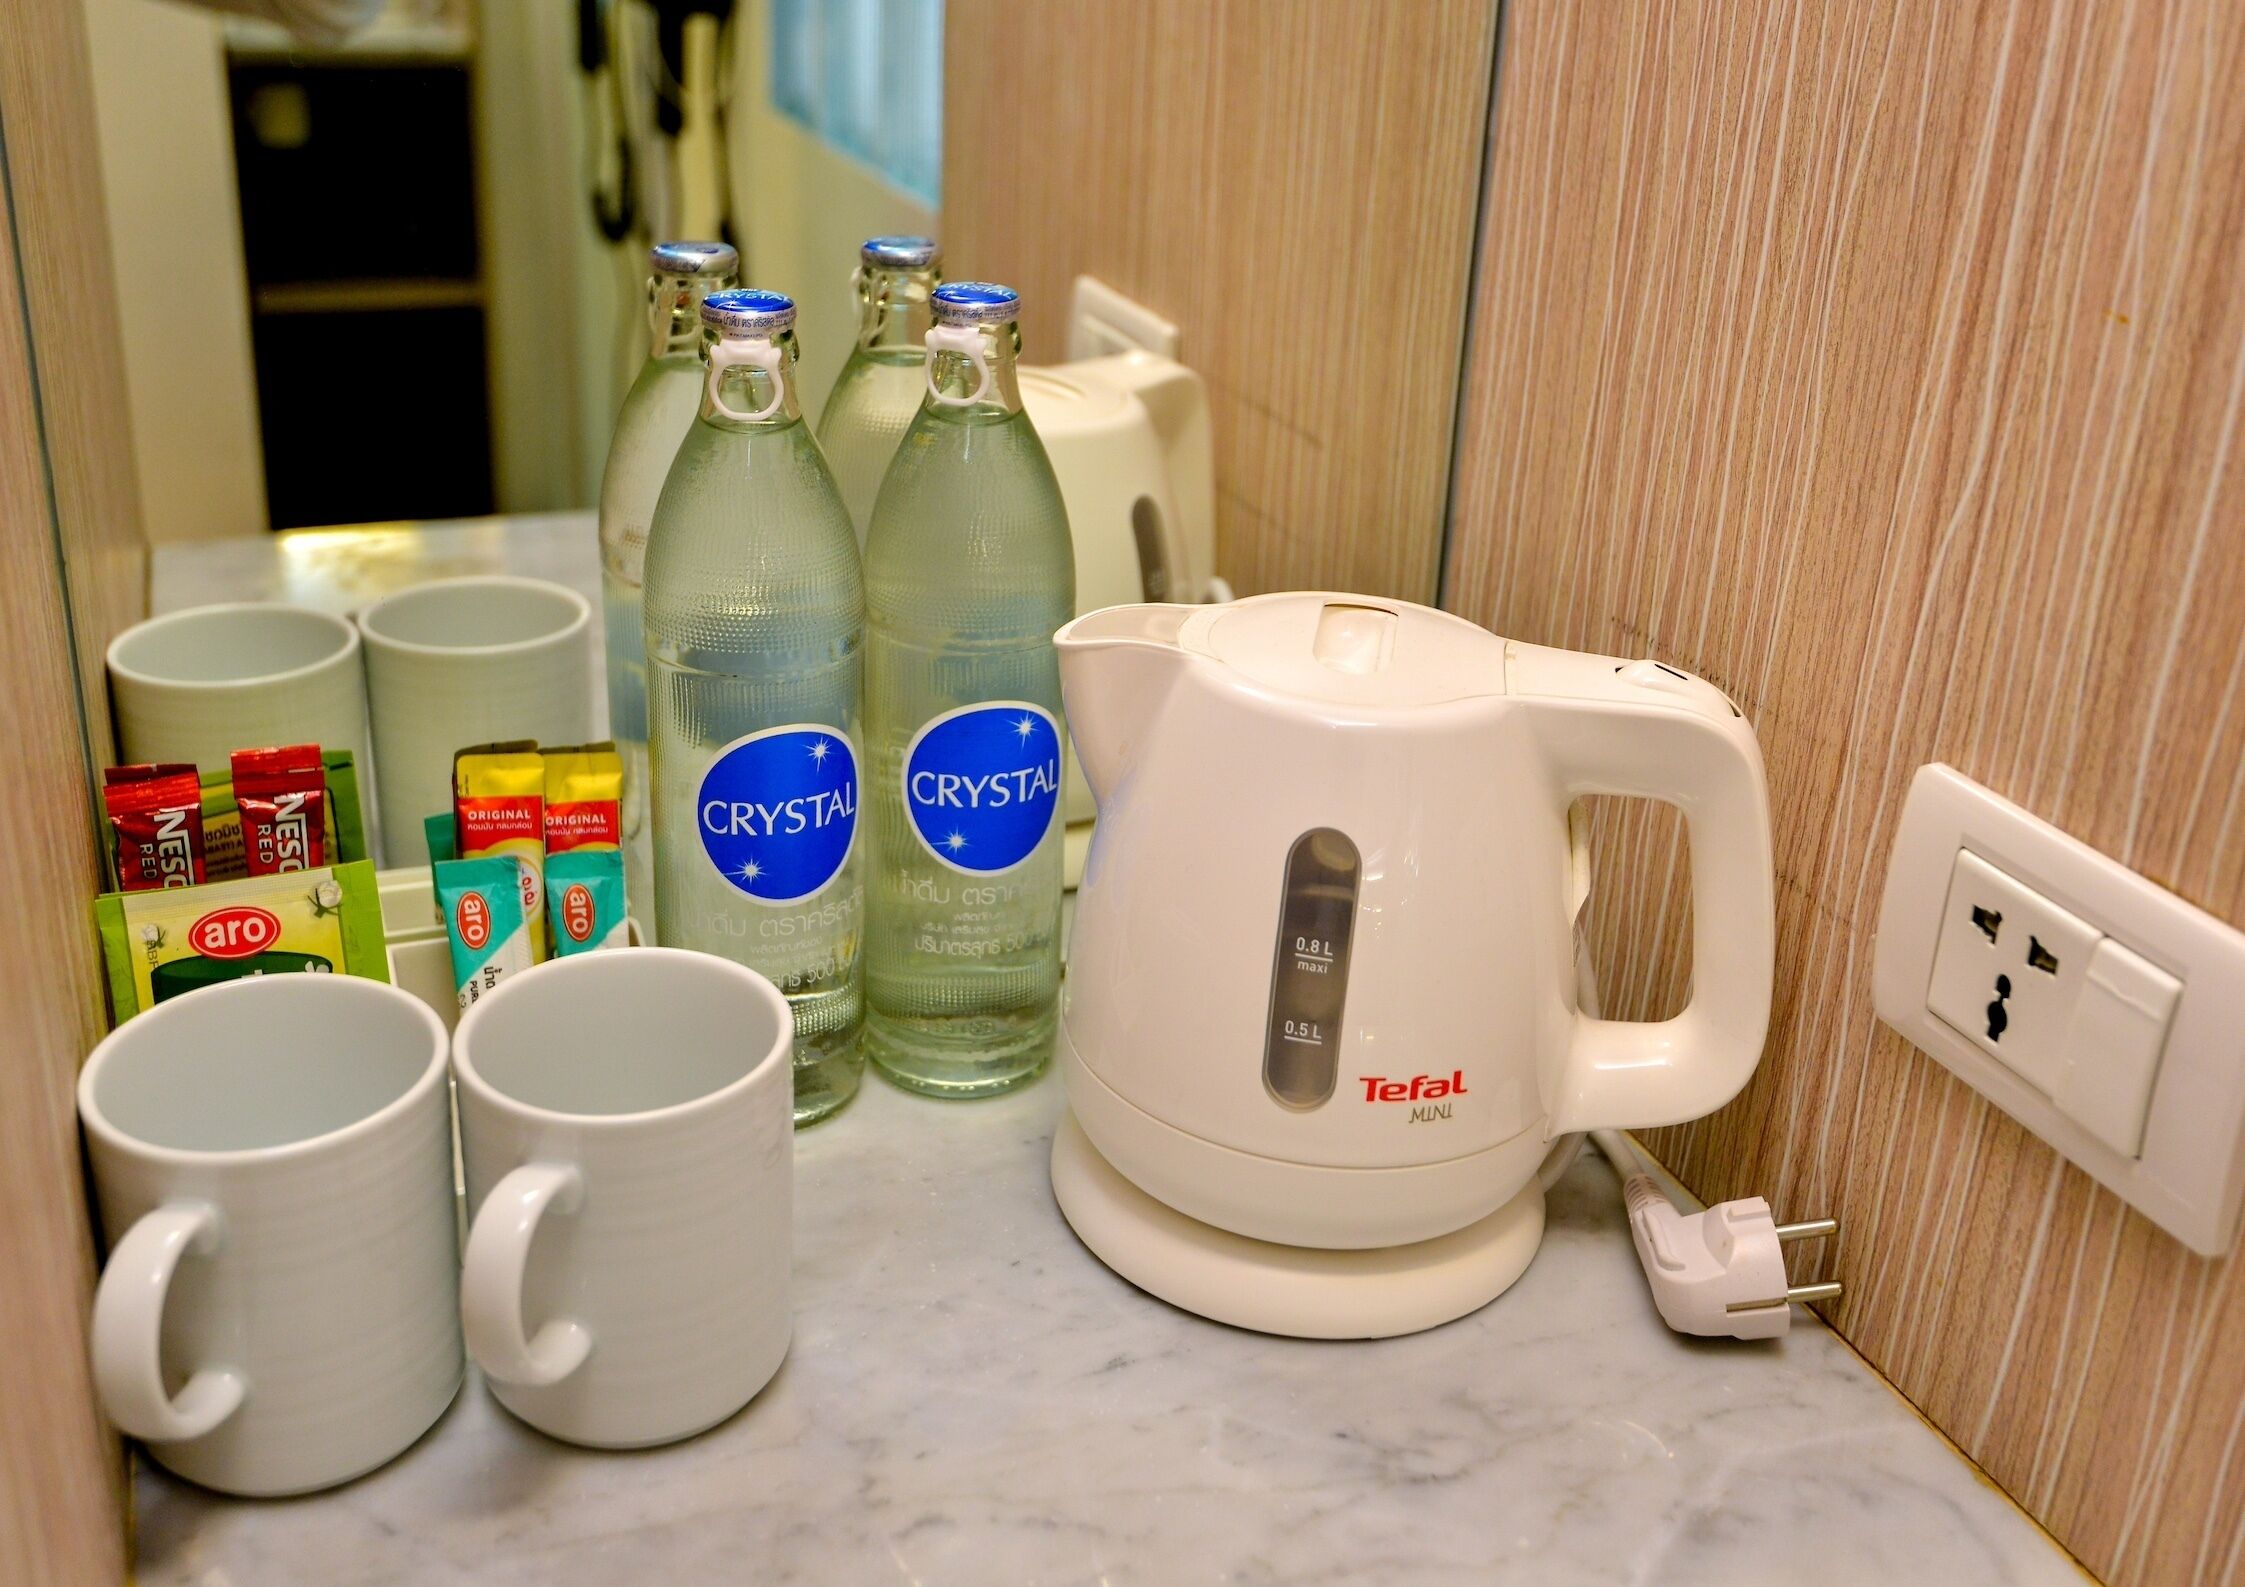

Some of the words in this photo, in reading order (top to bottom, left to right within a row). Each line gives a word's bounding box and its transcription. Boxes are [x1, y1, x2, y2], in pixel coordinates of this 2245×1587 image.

[911, 759, 1058, 808] CRYSTAL
[468, 809, 531, 821] ORIGINAL
[545, 813, 607, 826] ORIGINAL
[703, 782, 855, 836] CRYSTAL
[257, 824, 274, 864] RED
[140, 843, 157, 879] RED
[464, 899, 485, 941] aro
[570, 891, 589, 933] aro
[204, 916, 266, 949] aro
[1296, 936, 1320, 953] 0.8
[1324, 941, 1333, 956] L
[806, 957, 835, 984] 500
[1297, 959, 1328, 974] maxi
[1285, 1021, 1309, 1037] 0.5
[1313, 1025, 1322, 1039] L
[1359, 1070, 1468, 1102] Tefal
[1408, 1102, 1453, 1124] MINI
